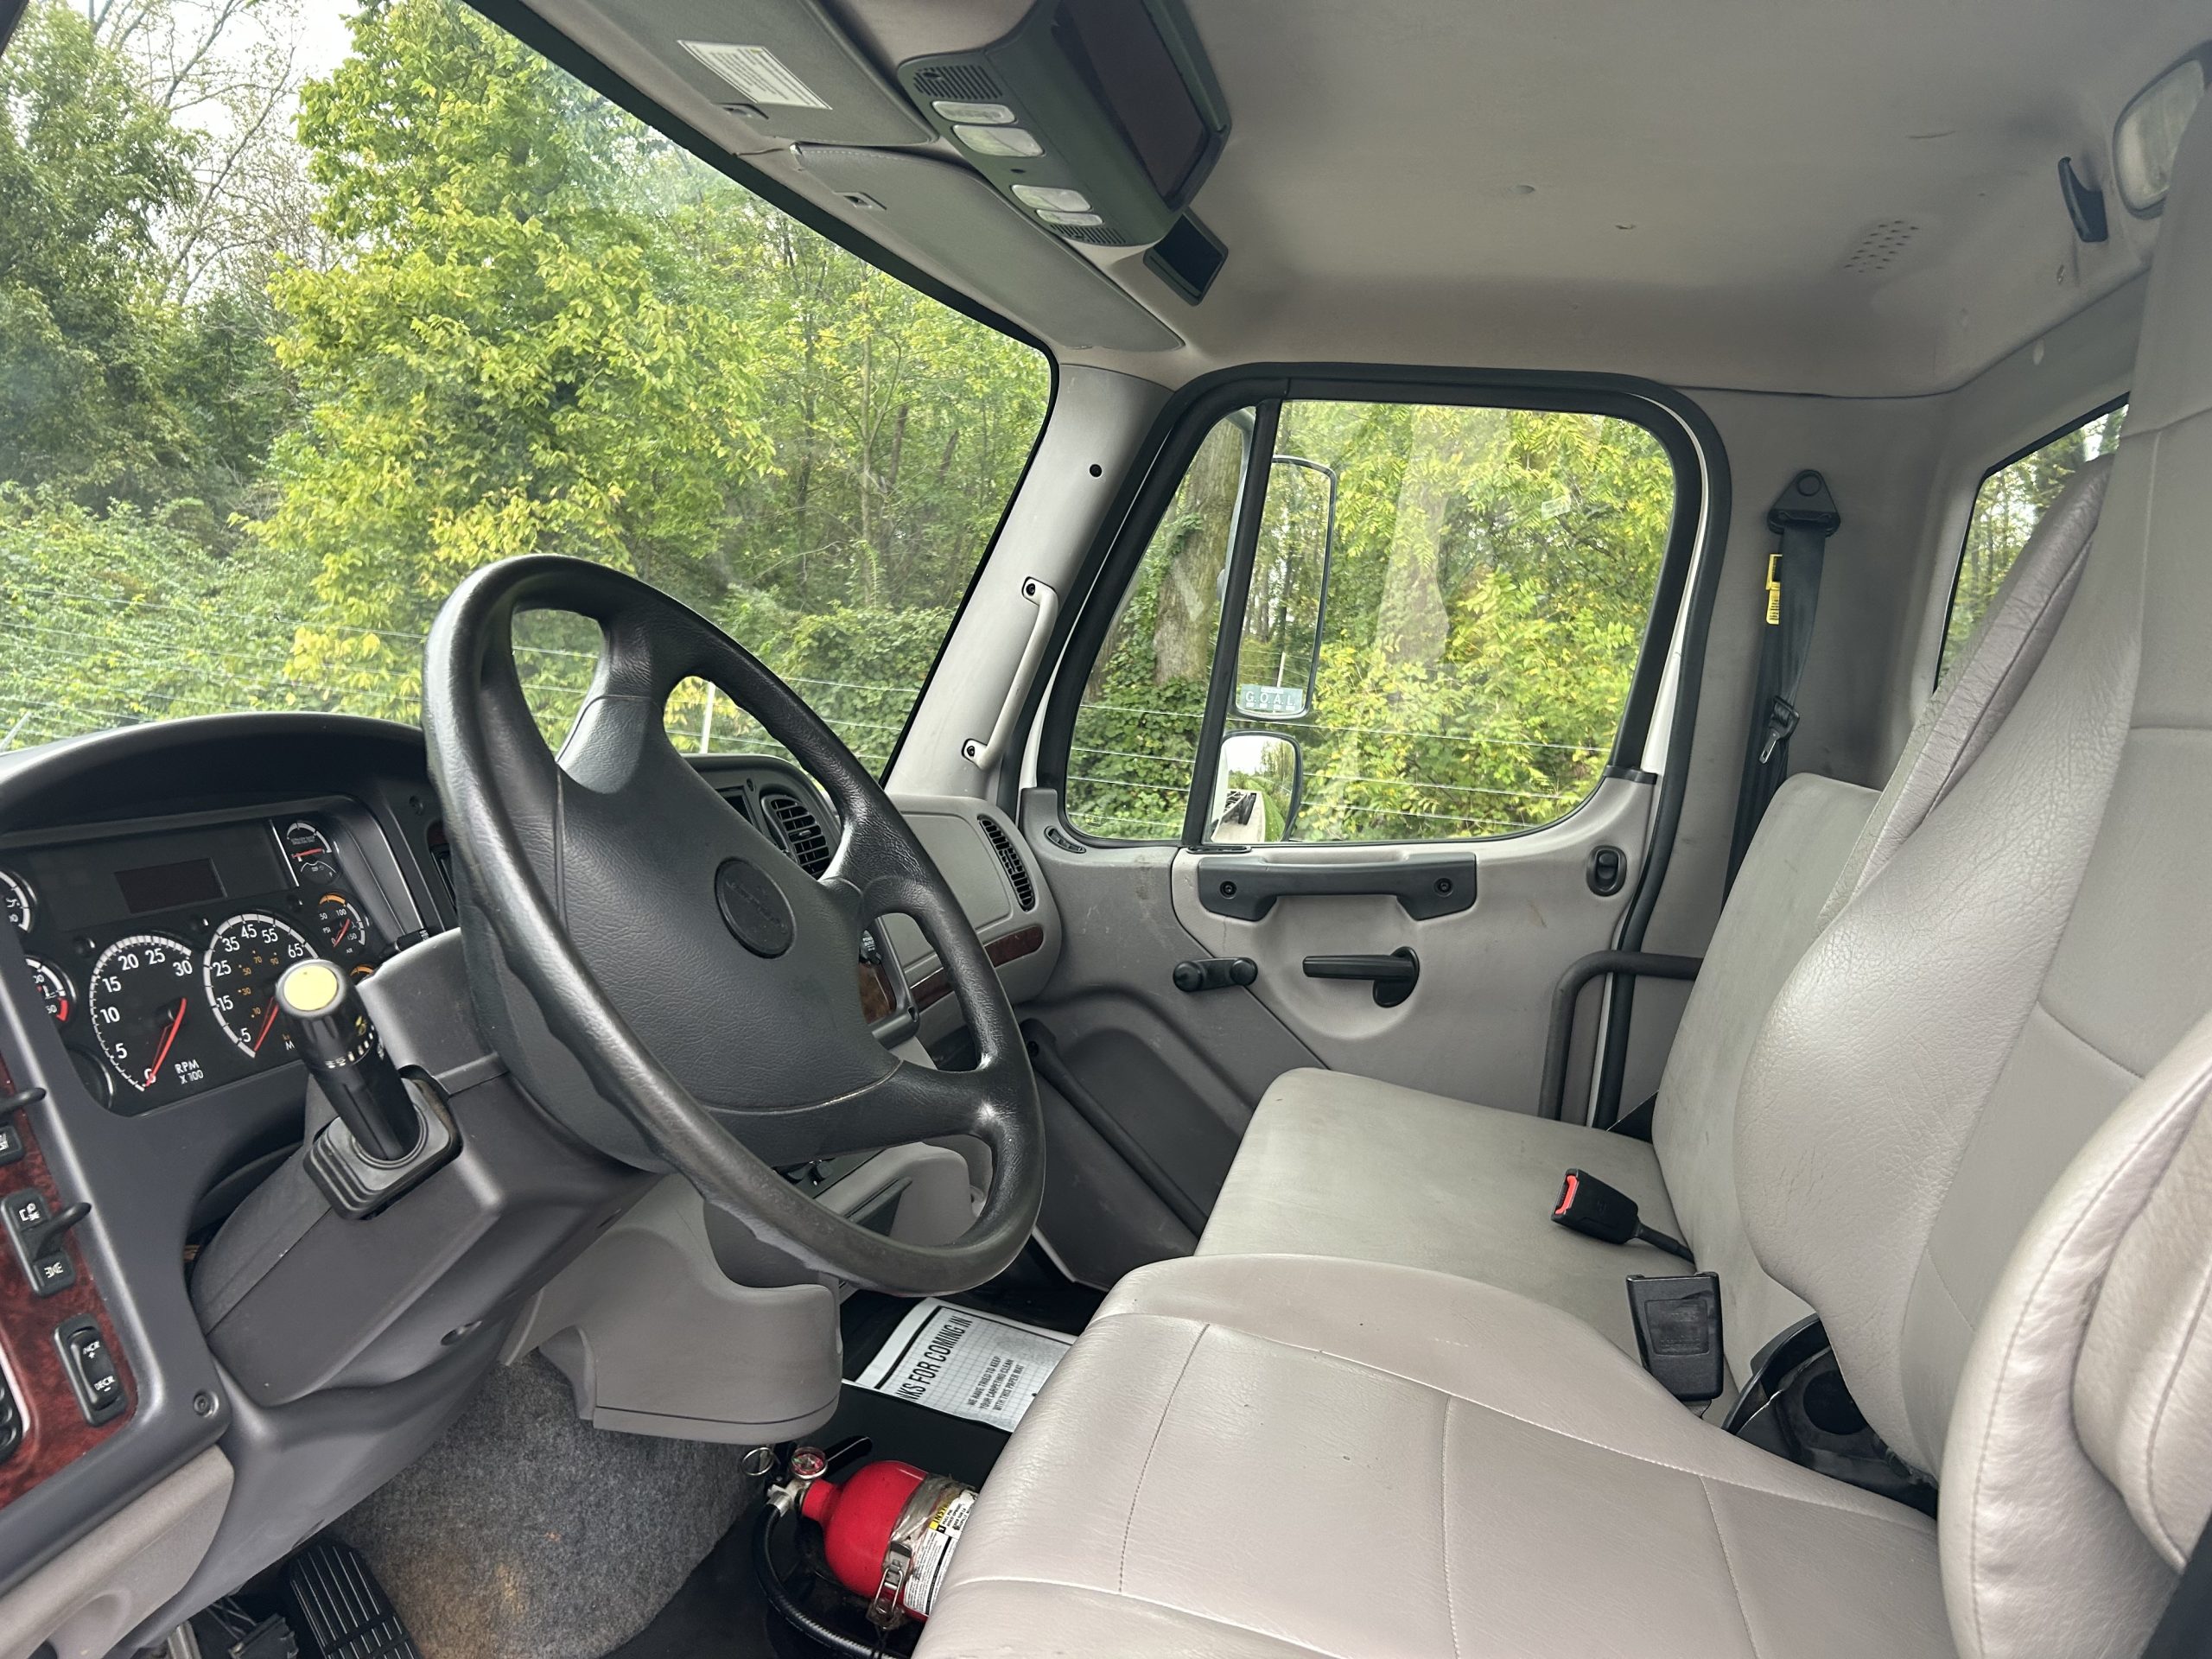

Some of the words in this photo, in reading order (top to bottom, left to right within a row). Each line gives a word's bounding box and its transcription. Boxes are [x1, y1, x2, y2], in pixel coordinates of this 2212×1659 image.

[241, 924, 257, 938] 45
[262, 928, 278, 944] 55
[222, 936, 240, 952] 35
[288, 943, 303, 958] 65
[118, 953, 139, 970] 20
[145, 948, 166, 965] 25
[173, 960, 193, 976] 30
[212, 960, 232, 976] 25
[102, 976, 122, 993] 15
[216, 995, 233, 1012] 15
[100, 1007, 120, 1023] 10
[240, 1027, 251, 1043] 5
[115, 1043, 127, 1059] 5
[175, 1059, 200, 1074] RPM
[179, 1074, 188, 1084] X
[188, 1069, 204, 1082] 100
[949, 1315, 973, 1328] IN
[924, 1324, 966, 1362] COMING
[989, 1356, 1001, 1368] KEEP
[1000, 1358, 1014, 1374] CLEAN
[908, 1361, 942, 1385] FOR
[977, 1373, 992, 1388] TRIED
[1004, 1373, 1020, 1389] PAPER
[94, 1376, 116, 1391] DECR
[970, 1387, 985, 1400] HAVE
